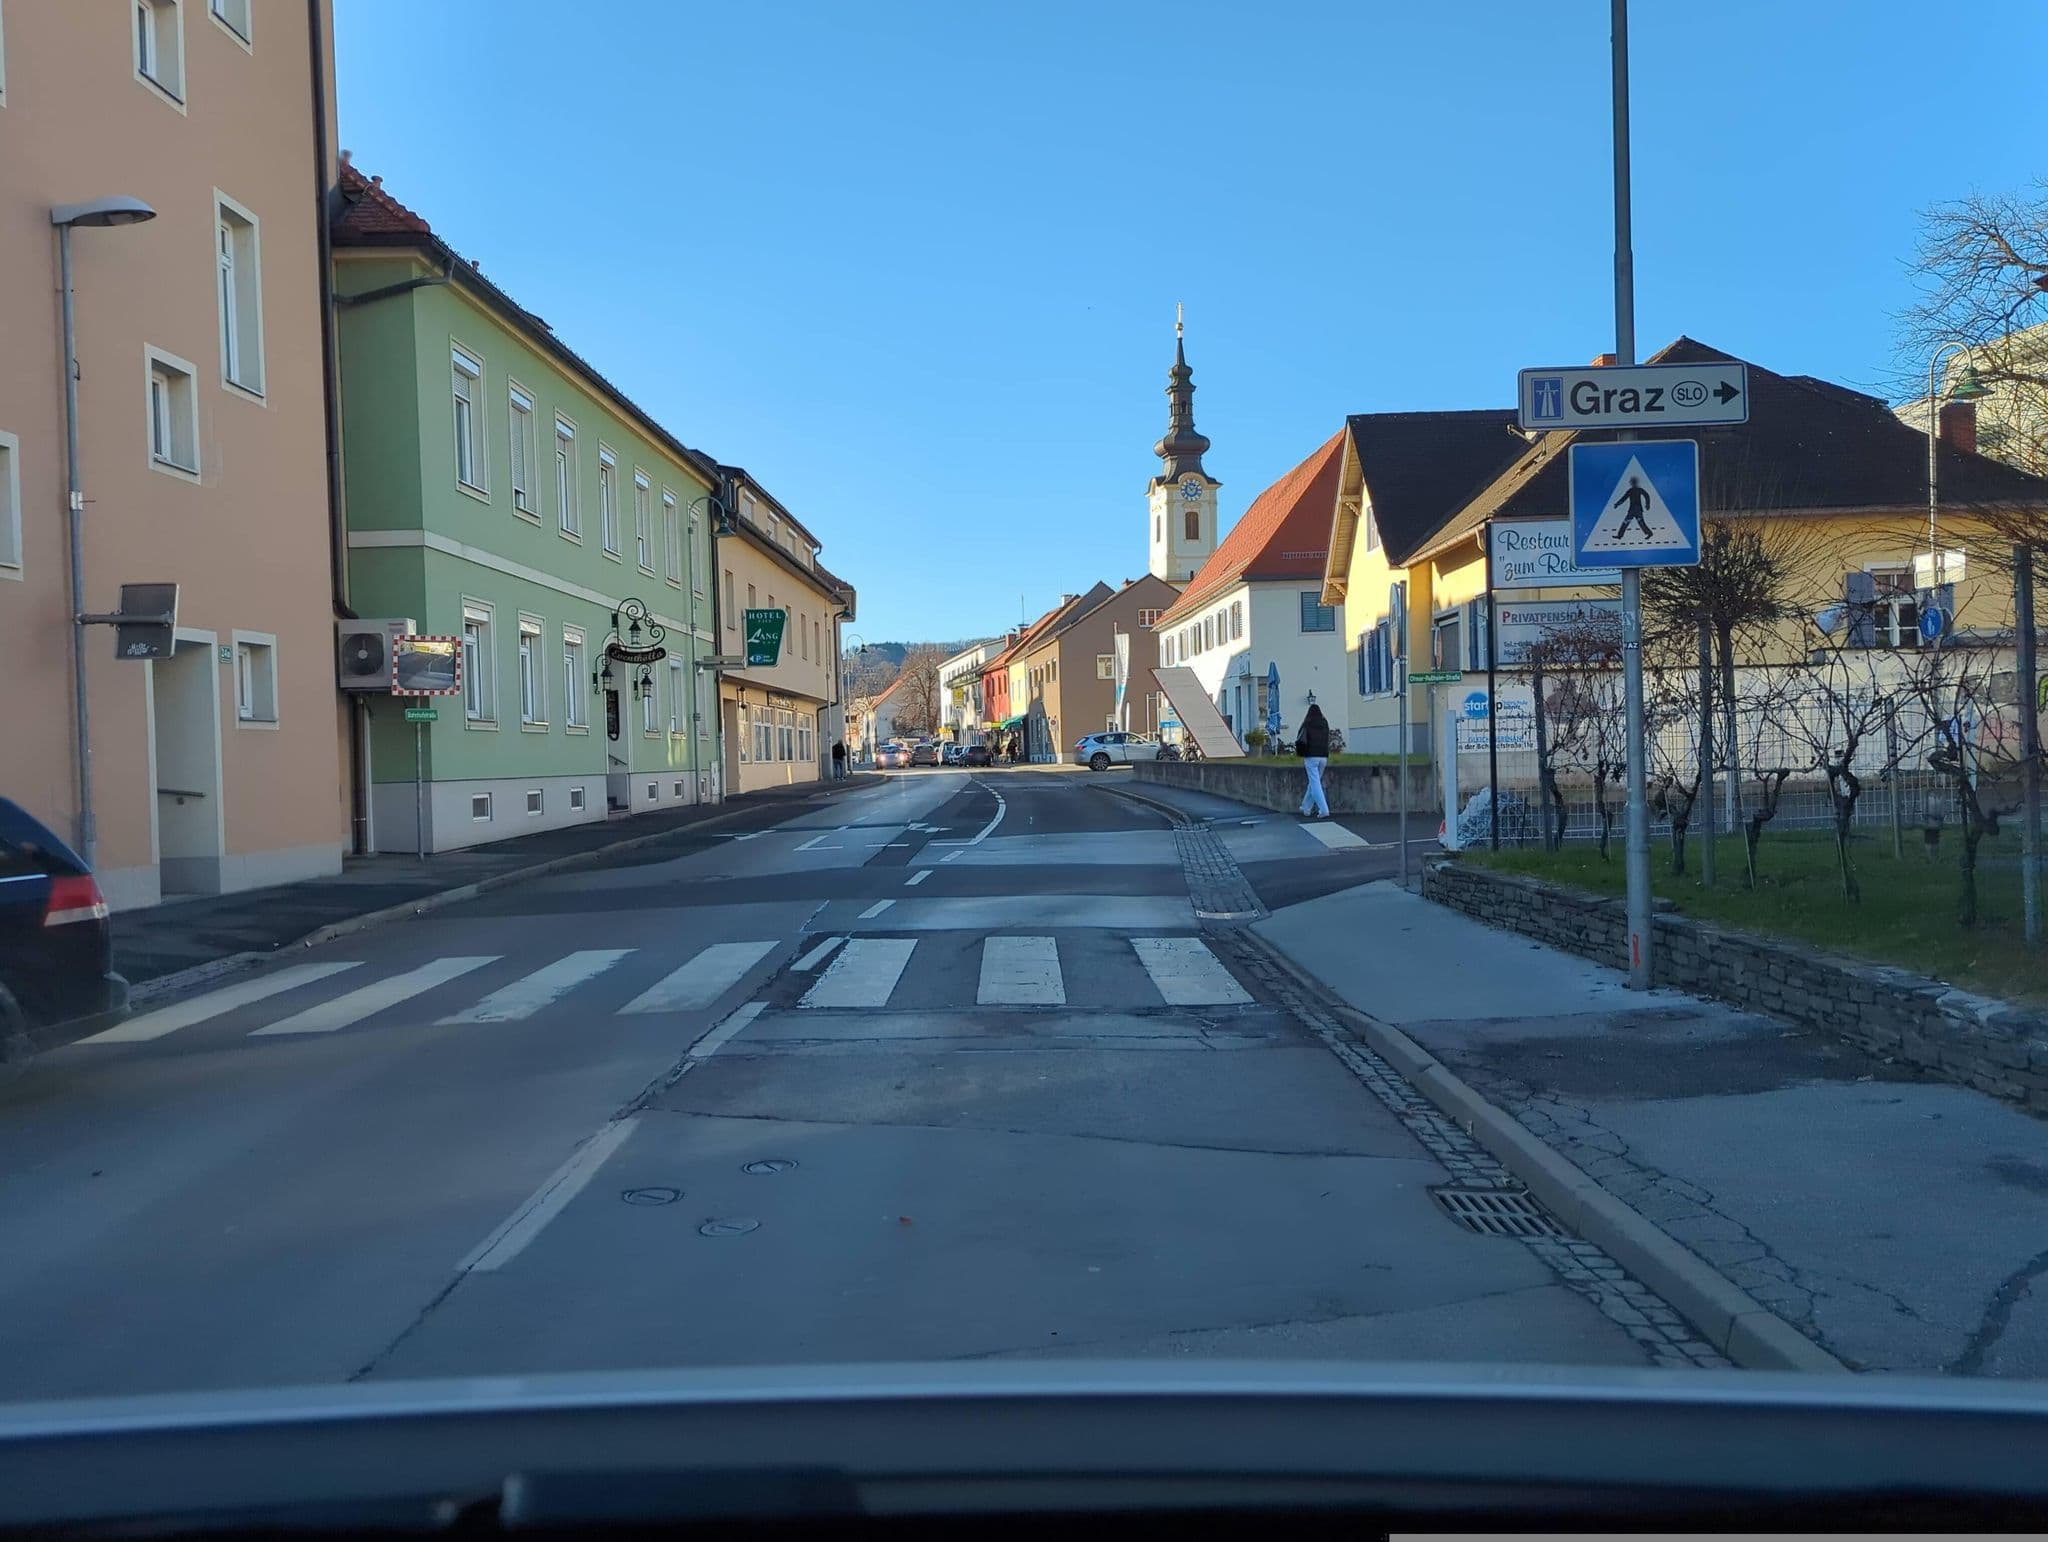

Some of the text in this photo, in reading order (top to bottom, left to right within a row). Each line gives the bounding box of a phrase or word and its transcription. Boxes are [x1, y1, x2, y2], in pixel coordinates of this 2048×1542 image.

[1570, 380, 1703, 415] Graz SLO
[1498, 530, 1570, 551] Restaur
[1464, 700, 1503, 713] startp
